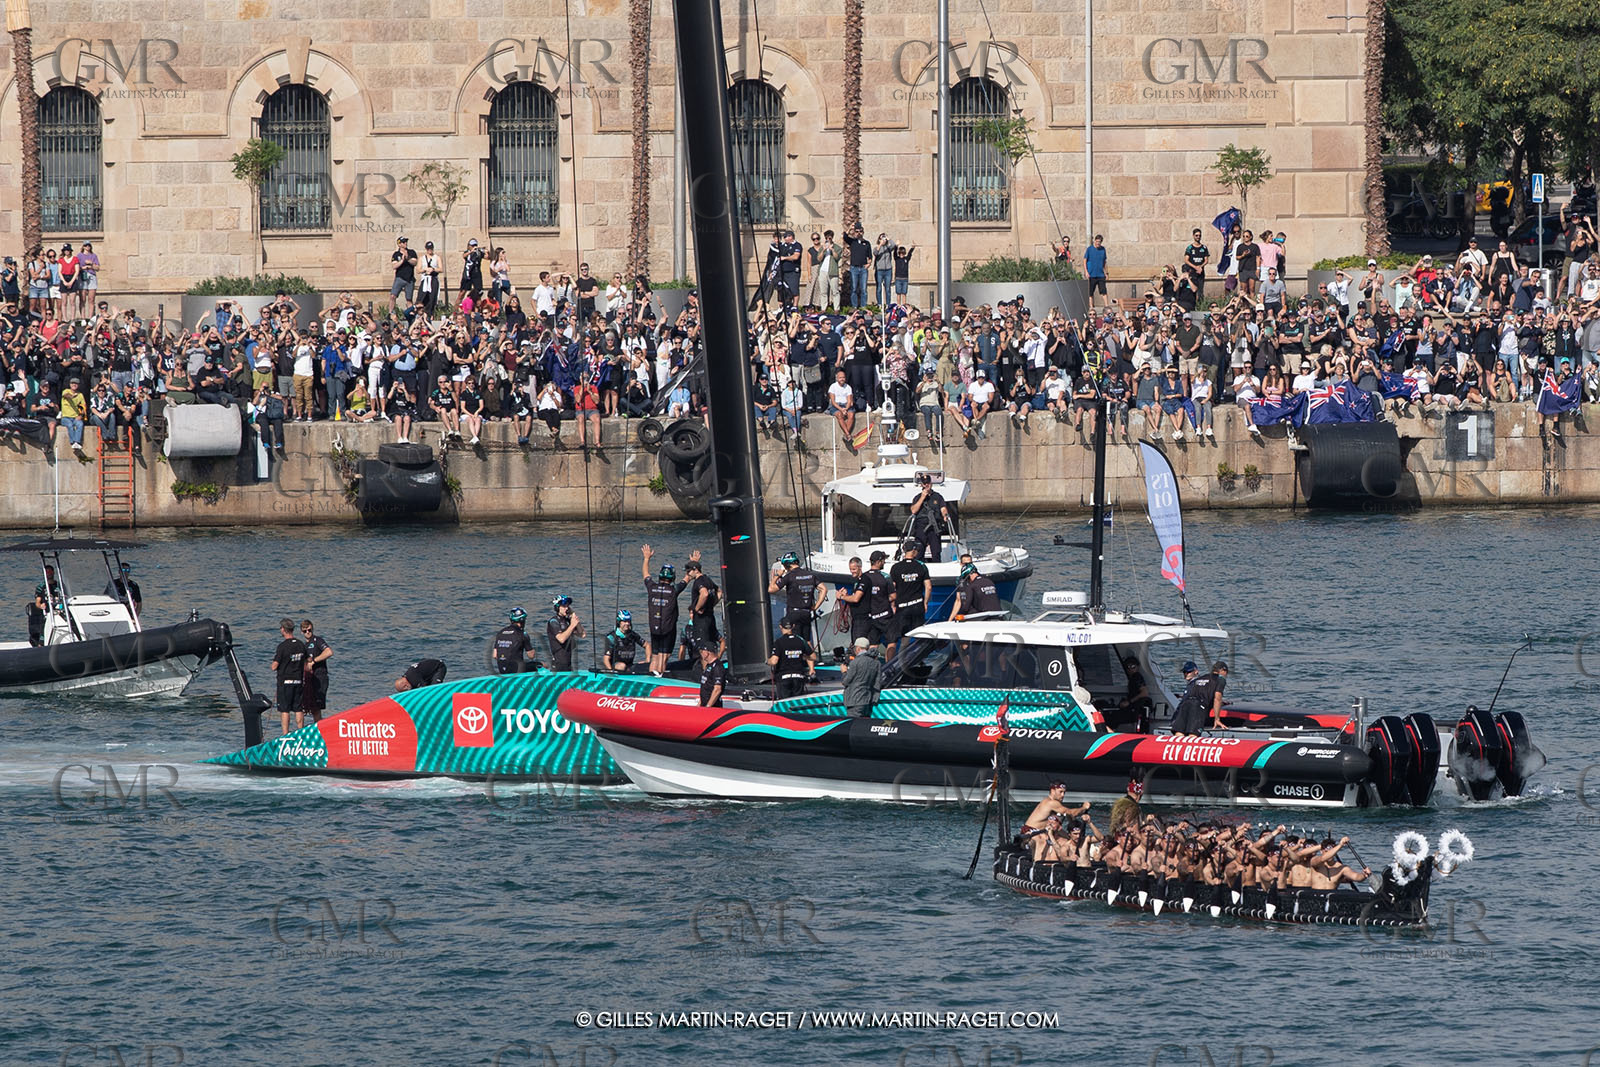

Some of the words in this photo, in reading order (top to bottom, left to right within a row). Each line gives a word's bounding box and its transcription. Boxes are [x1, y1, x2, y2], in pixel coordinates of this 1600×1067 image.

[1458, 415, 1477, 456] 1
[597, 697, 637, 712] OMEGA
[338, 719, 396, 739] Emirates
[500, 708, 590, 734] TOYO
[1008, 727, 1063, 740] TOYOTA
[278, 738, 324, 761] Taihoro
[348, 741, 360, 755] FLY
[362, 741, 389, 756] BETTER
[1162, 744, 1183, 761] FLY
[1183, 745, 1223, 763] BETTER
[1273, 784, 1309, 797] CHASE
